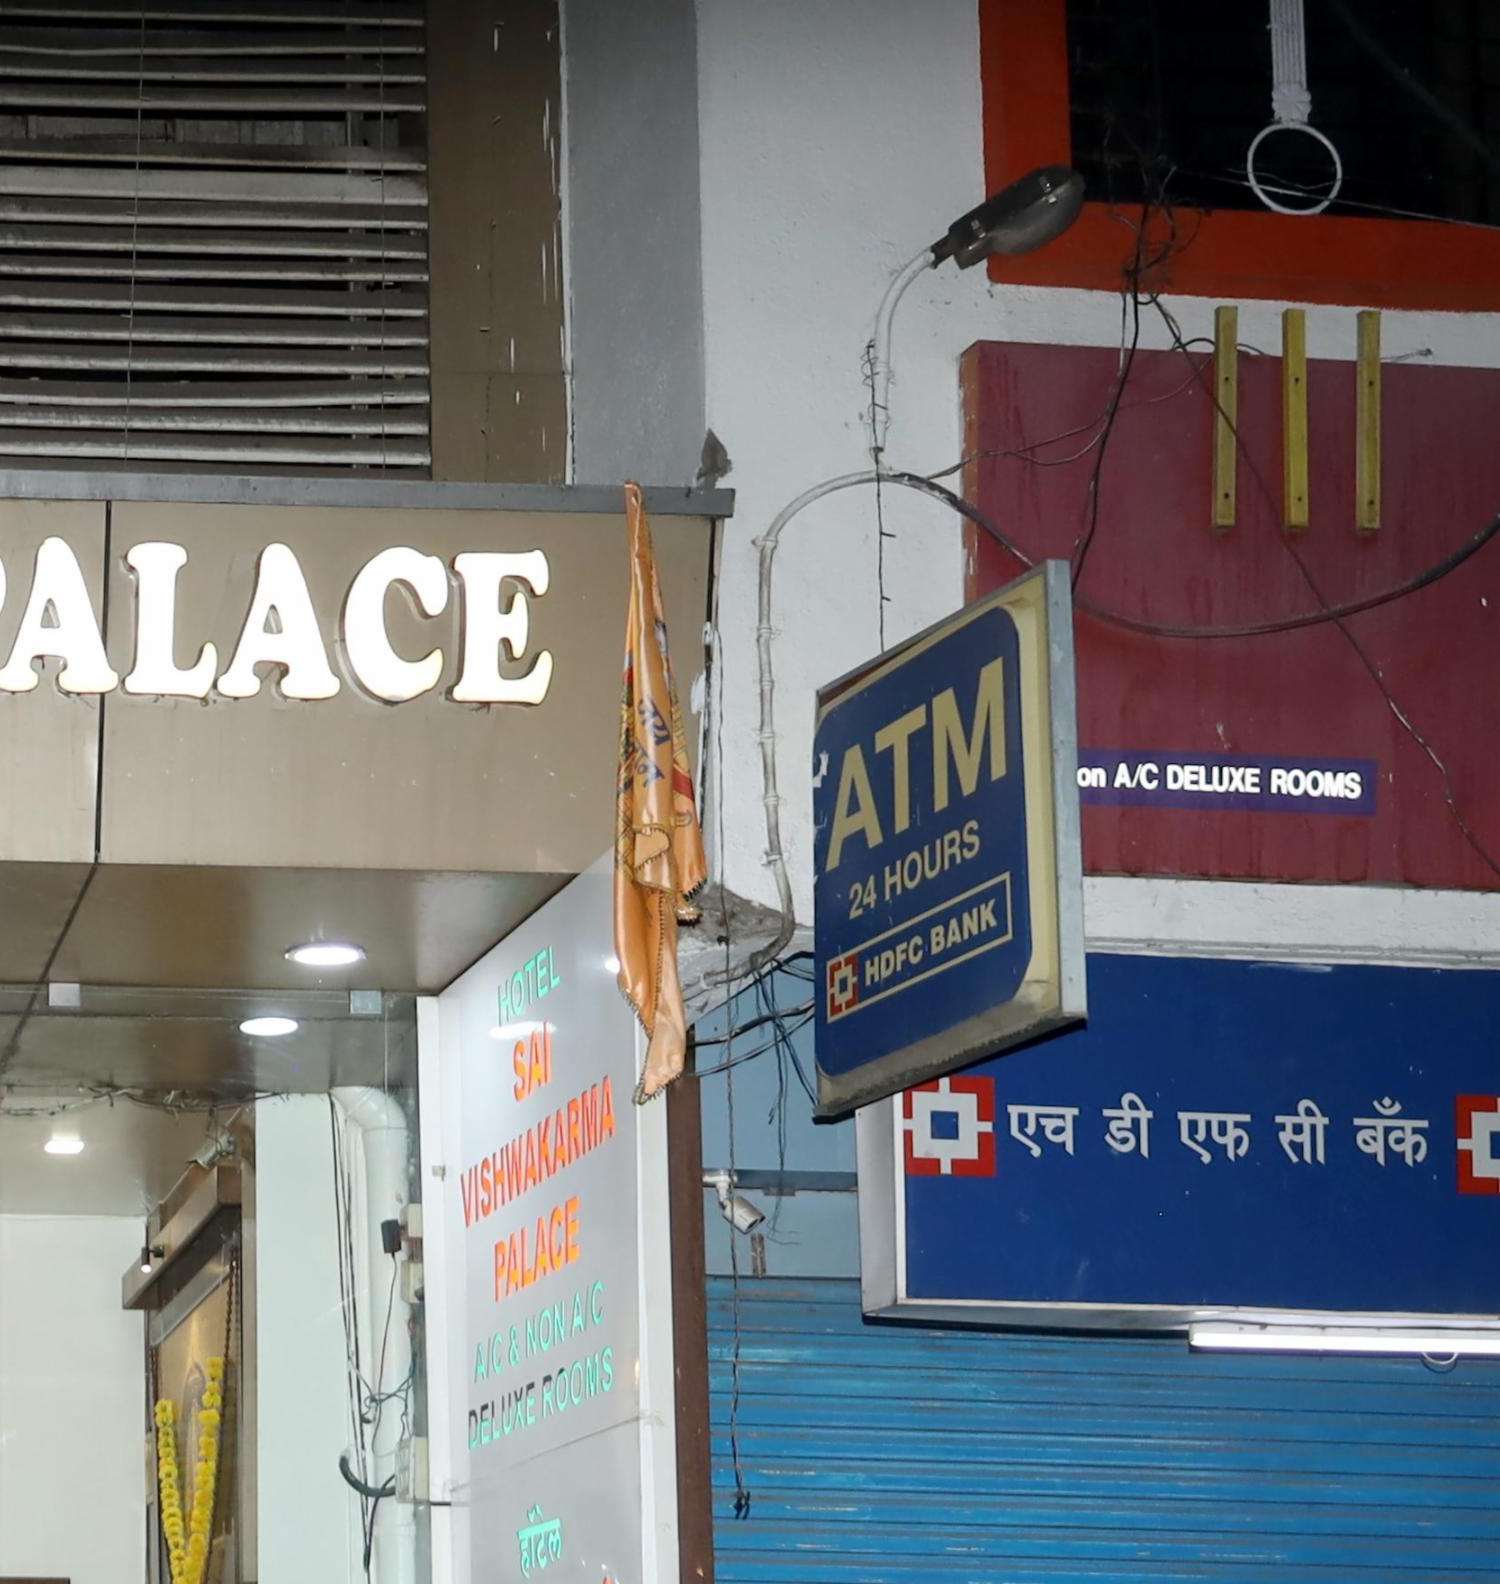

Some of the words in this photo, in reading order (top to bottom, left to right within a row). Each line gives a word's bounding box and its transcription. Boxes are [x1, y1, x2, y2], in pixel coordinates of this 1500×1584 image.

[826, 656, 1006, 872] ATM
[1076, 766, 1107, 788] on
[1113, 762, 1160, 791] A/C
[1166, 763, 1261, 794] DELUXE
[1270, 768, 1363, 800] ROOMS
[848, 874, 877, 920] 24
[884, 819, 981, 901] HOURS
[497, 945, 561, 1027] HOTEL
[864, 935, 924, 987] HDFC
[930, 898, 998, 956] BANK
[512, 1021, 553, 1102] SAI
[460, 1074, 616, 1228] VISHWAKARMA
[1006, 1103, 1081, 1157] एच
[1103, 1091, 1154, 1160] डी
[1176, 1110, 1252, 1165] एफ
[1275, 1098, 1330, 1166] सी
[1352, 1096, 1429, 1167] बँक
[493, 1196, 581, 1302] PALACE
[474, 1330, 504, 1384] A/C
[508, 1324, 519, 1368] &
[525, 1300, 566, 1356] NON
[571, 1280, 605, 1340] A/C
[468, 1380, 536, 1449] DELUXE
[541, 1345, 614, 1423] ROOMS
